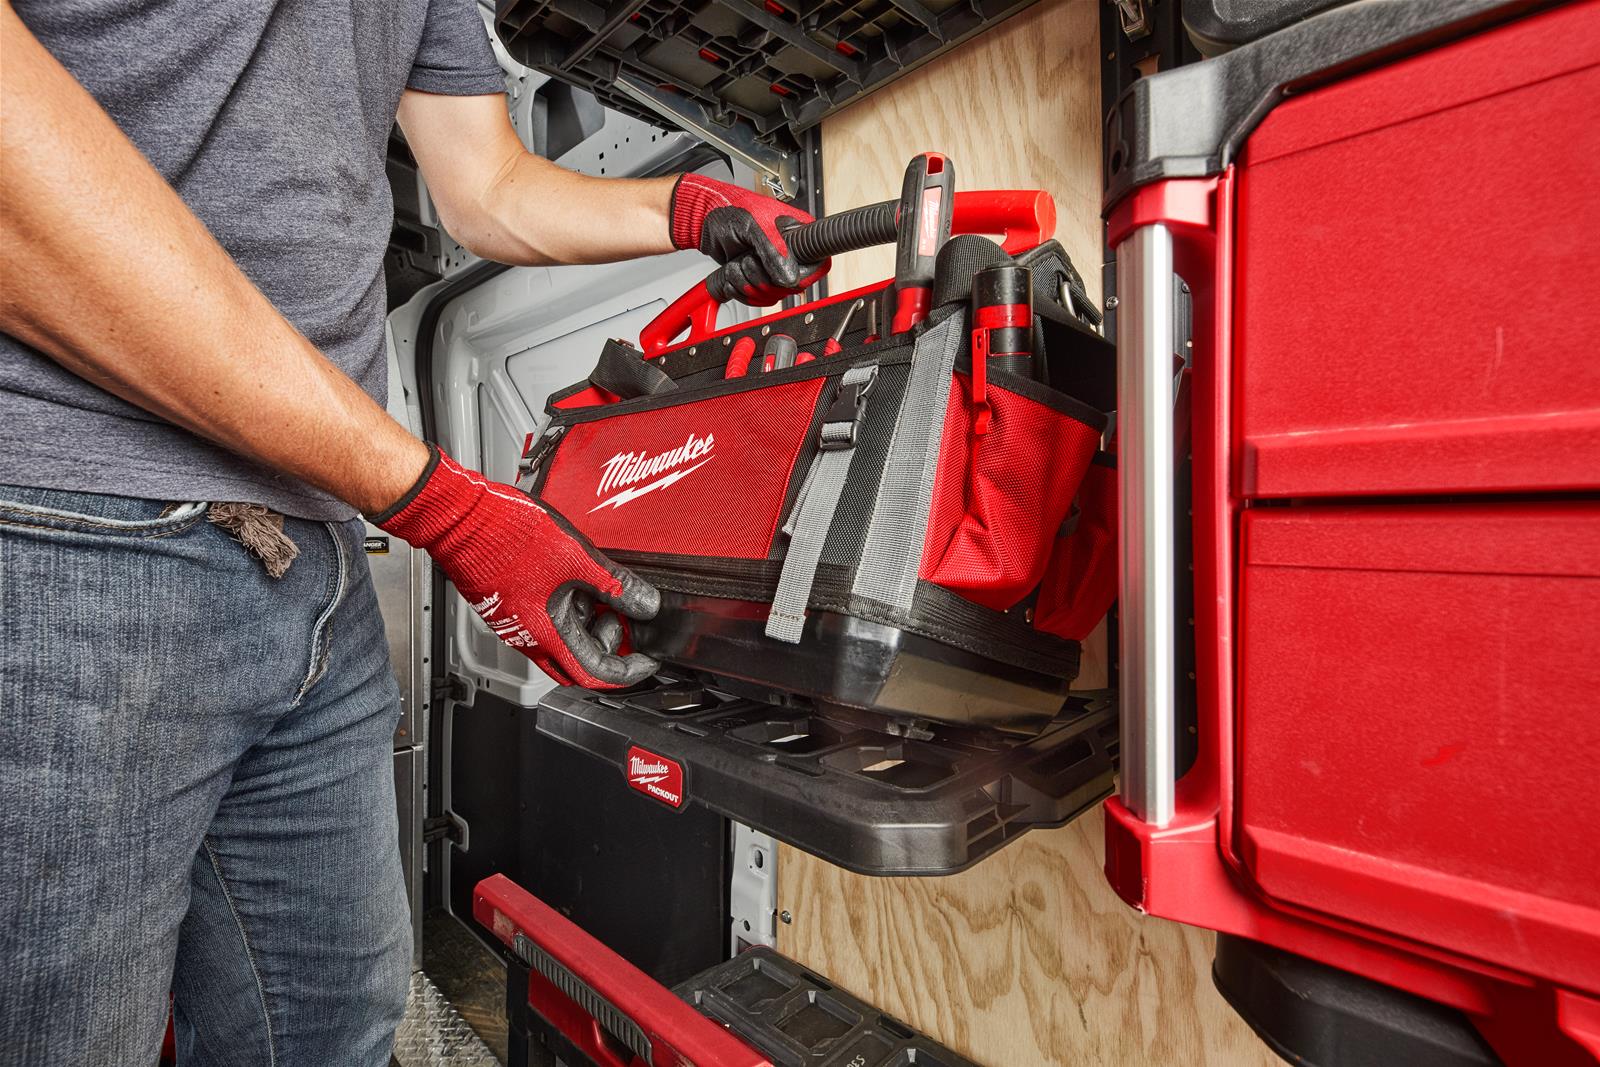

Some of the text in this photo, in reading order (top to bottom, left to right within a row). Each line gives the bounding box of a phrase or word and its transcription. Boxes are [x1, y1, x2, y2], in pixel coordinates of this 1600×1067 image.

[597, 432, 715, 497] Milwaukee
[630, 755, 669, 776] Milwaukee
[647, 783, 680, 803] PACKOUT
